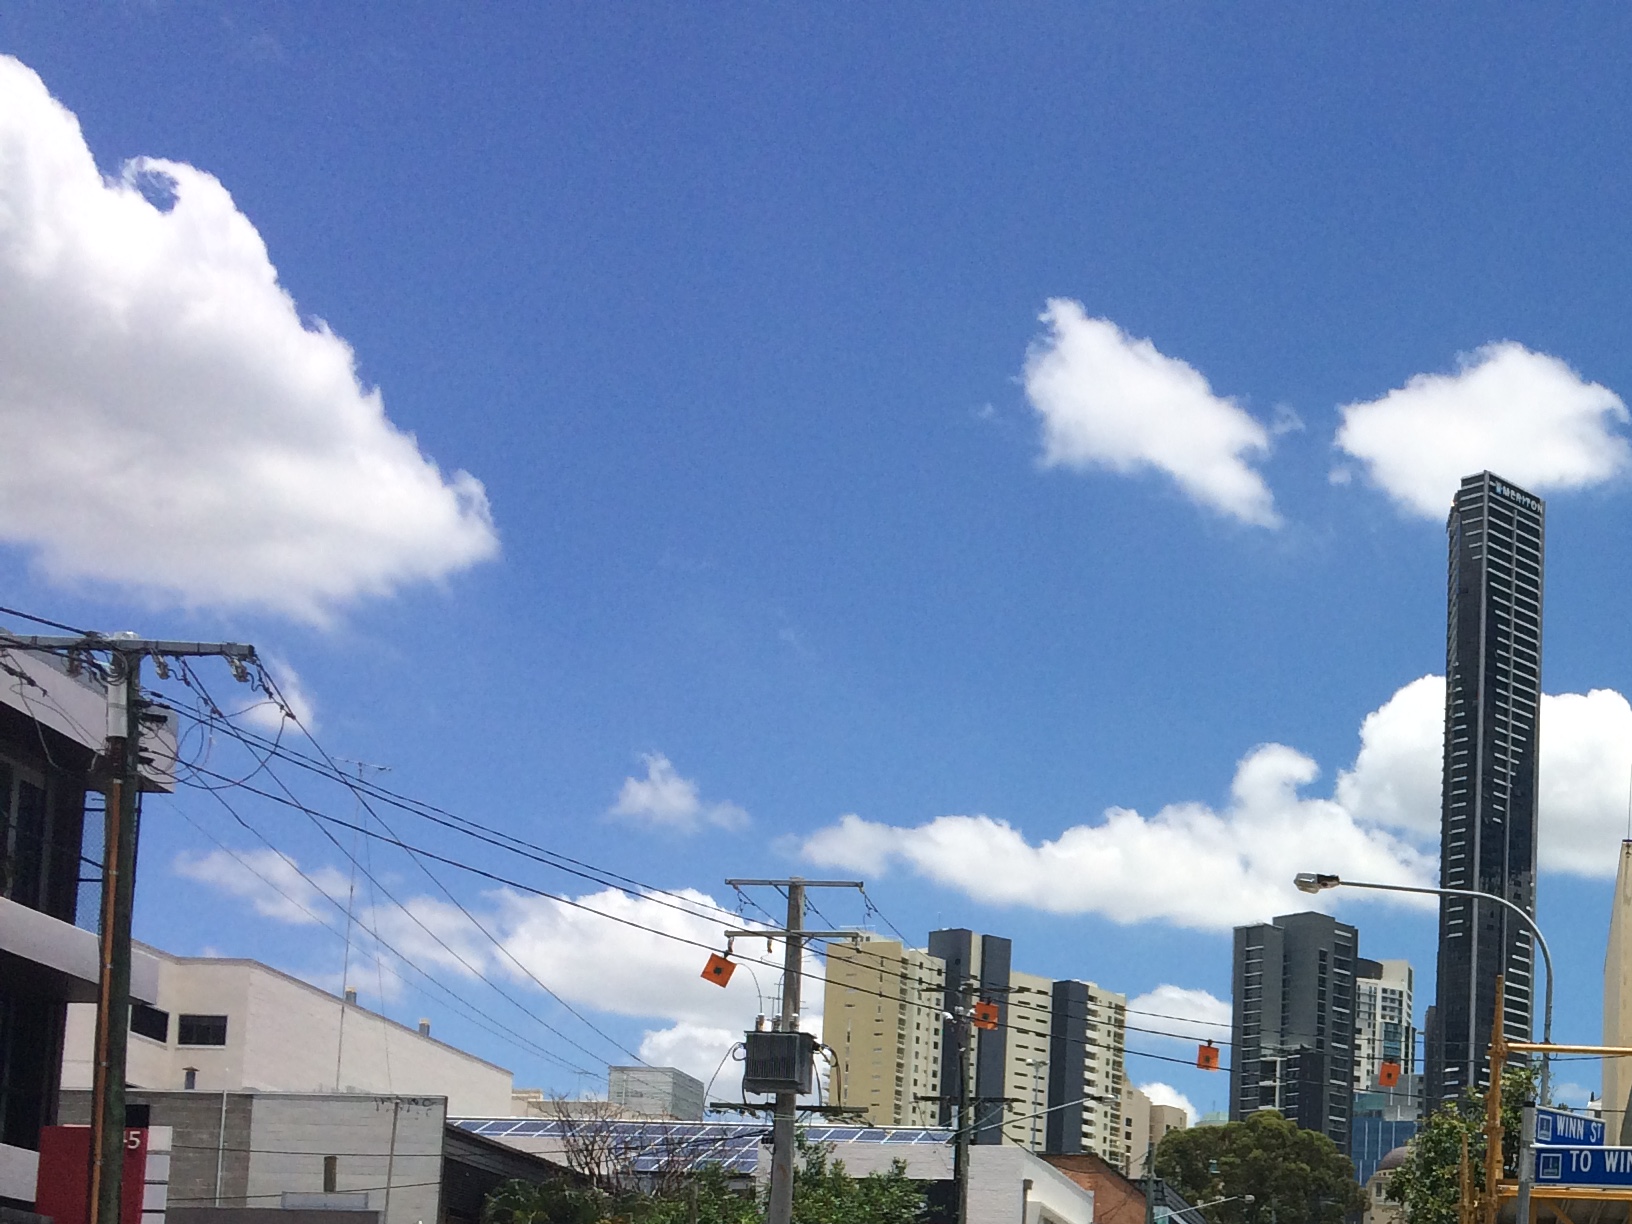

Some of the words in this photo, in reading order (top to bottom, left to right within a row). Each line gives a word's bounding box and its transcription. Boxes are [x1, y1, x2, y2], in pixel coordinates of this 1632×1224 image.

[1502, 485, 1543, 514] MERITON
[1556, 1114, 1584, 1140] WINN
[1590, 1121, 1603, 1143] ST
[1569, 1150, 1592, 1173] TO
